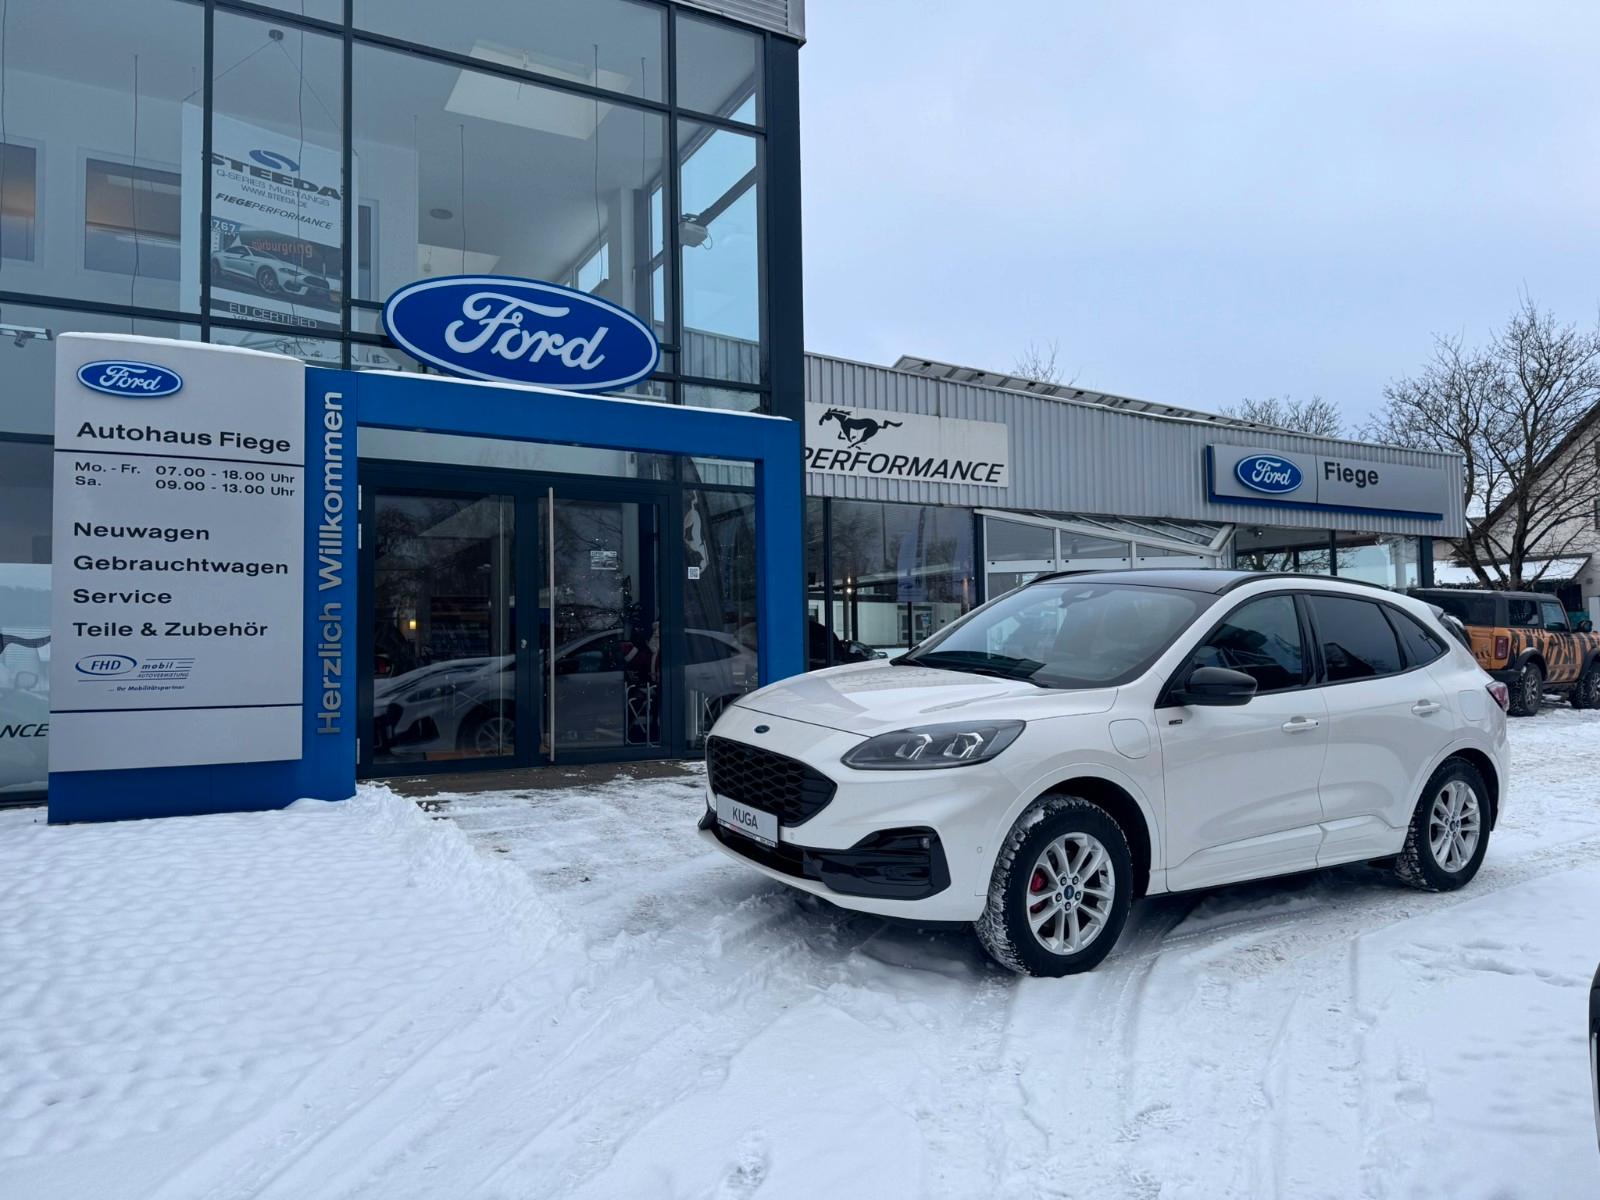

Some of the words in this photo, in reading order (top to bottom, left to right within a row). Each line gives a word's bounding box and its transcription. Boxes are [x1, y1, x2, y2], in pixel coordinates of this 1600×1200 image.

[229, 302, 248, 315] EU
[444, 291, 609, 371] Ford
[99, 364, 161, 392] Ford
[76, 421, 213, 446] Autohaus
[219, 431, 291, 454] Fiege
[75, 461, 107, 473] Mo.
[121, 463, 141, 474] Fr.
[155, 465, 205, 478] 07.00
[222, 469, 265, 482] 18.00
[270, 473, 295, 484] Uhr
[1251, 459, 1292, 486] Ford
[1323, 460, 1379, 488] Fiege
[75, 475, 102, 487] Sa.
[155, 479, 205, 492] 09.00
[222, 483, 265, 495] 13.00
[270, 486, 295, 497] Uhr
[318, 391, 343, 592] Willkommen
[73, 521, 210, 543] Neuwagen
[73, 555, 288, 577] Gebrauchtwagen
[73, 588, 172, 604] Service
[73, 622, 133, 637] Teile
[140, 622, 158, 637] &
[164, 621, 269, 637] Zubehör
[91, 660, 121, 671] FHD
[141, 661, 174, 670] mobil
[317, 602, 342, 735] Herzlich
[732, 805, 759, 830] KUGA
